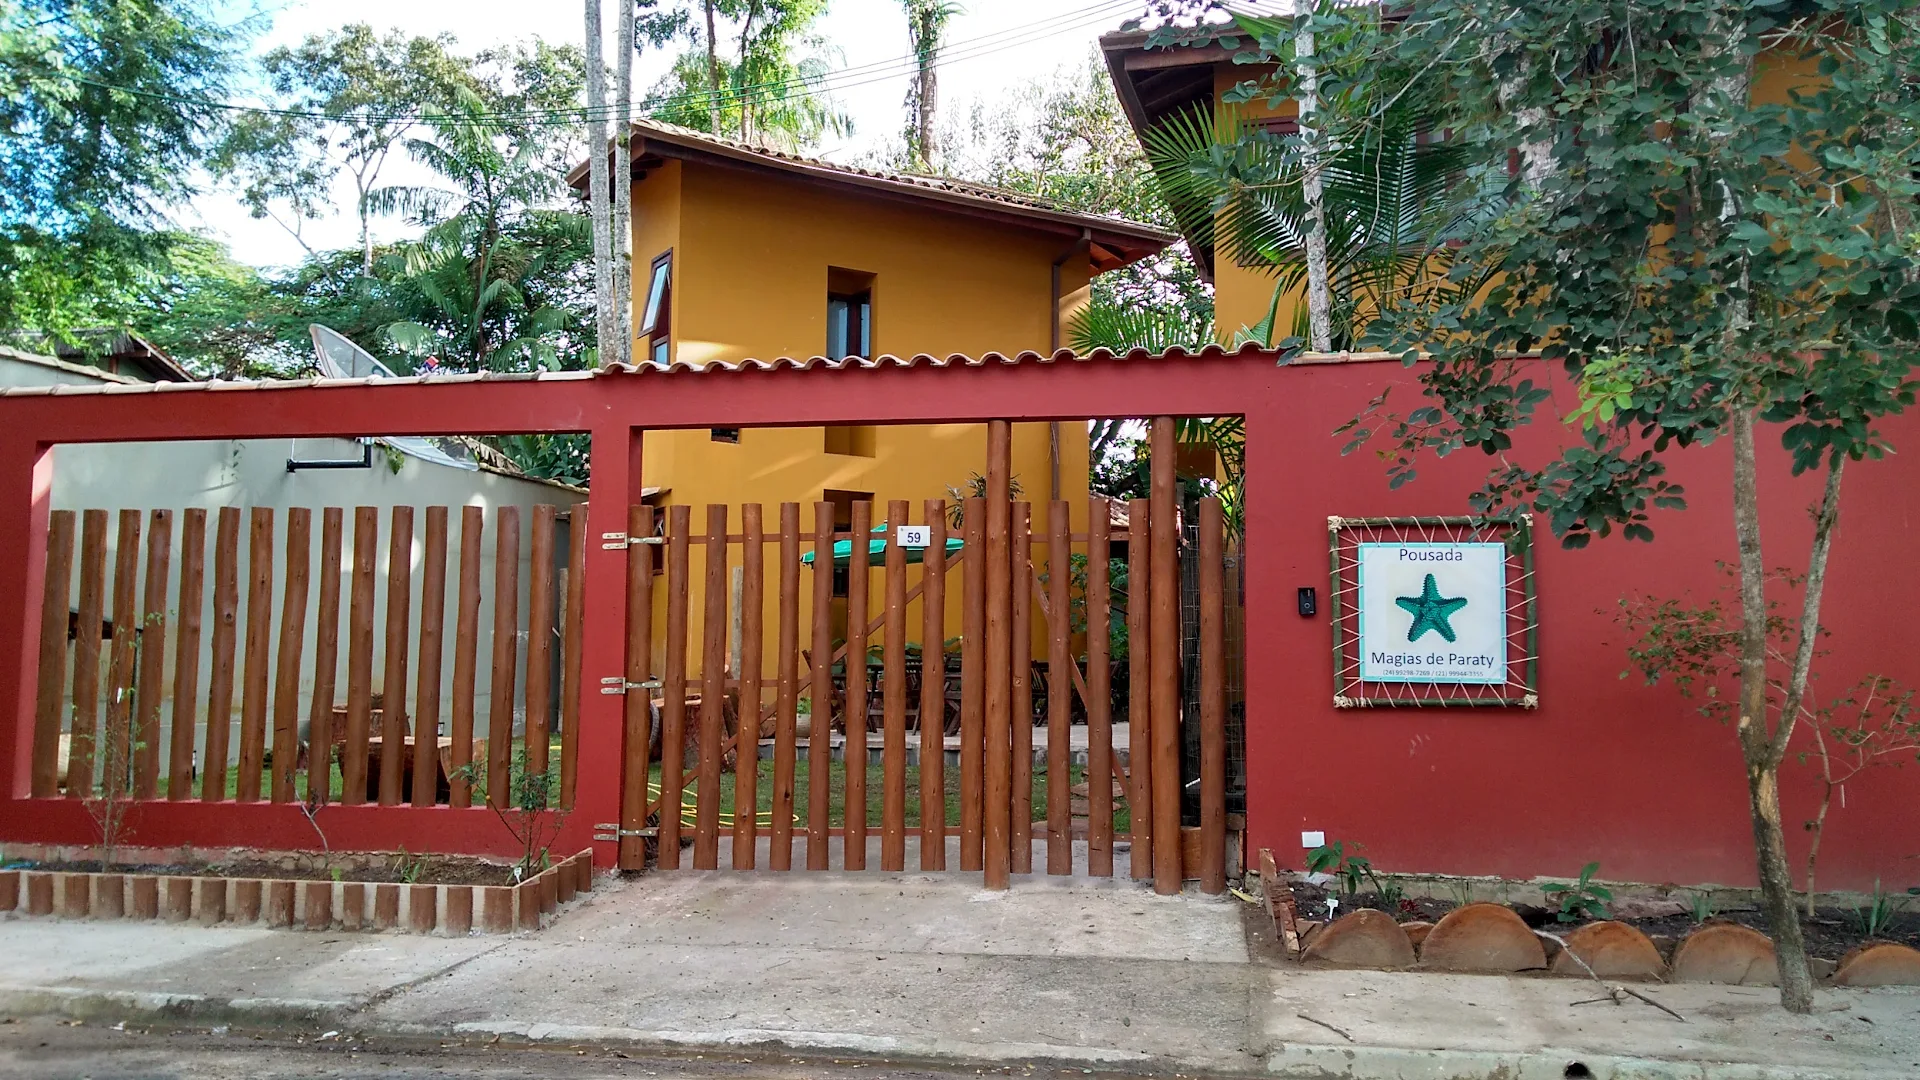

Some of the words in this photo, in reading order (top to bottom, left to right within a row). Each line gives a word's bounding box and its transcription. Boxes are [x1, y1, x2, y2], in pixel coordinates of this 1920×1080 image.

[907, 532, 921, 543] 59
[1399, 548, 1463, 561] Pousada
[1371, 652, 1422, 667] Magias
[1426, 652, 1444, 665] de
[1449, 653, 1494, 668] Paraty
